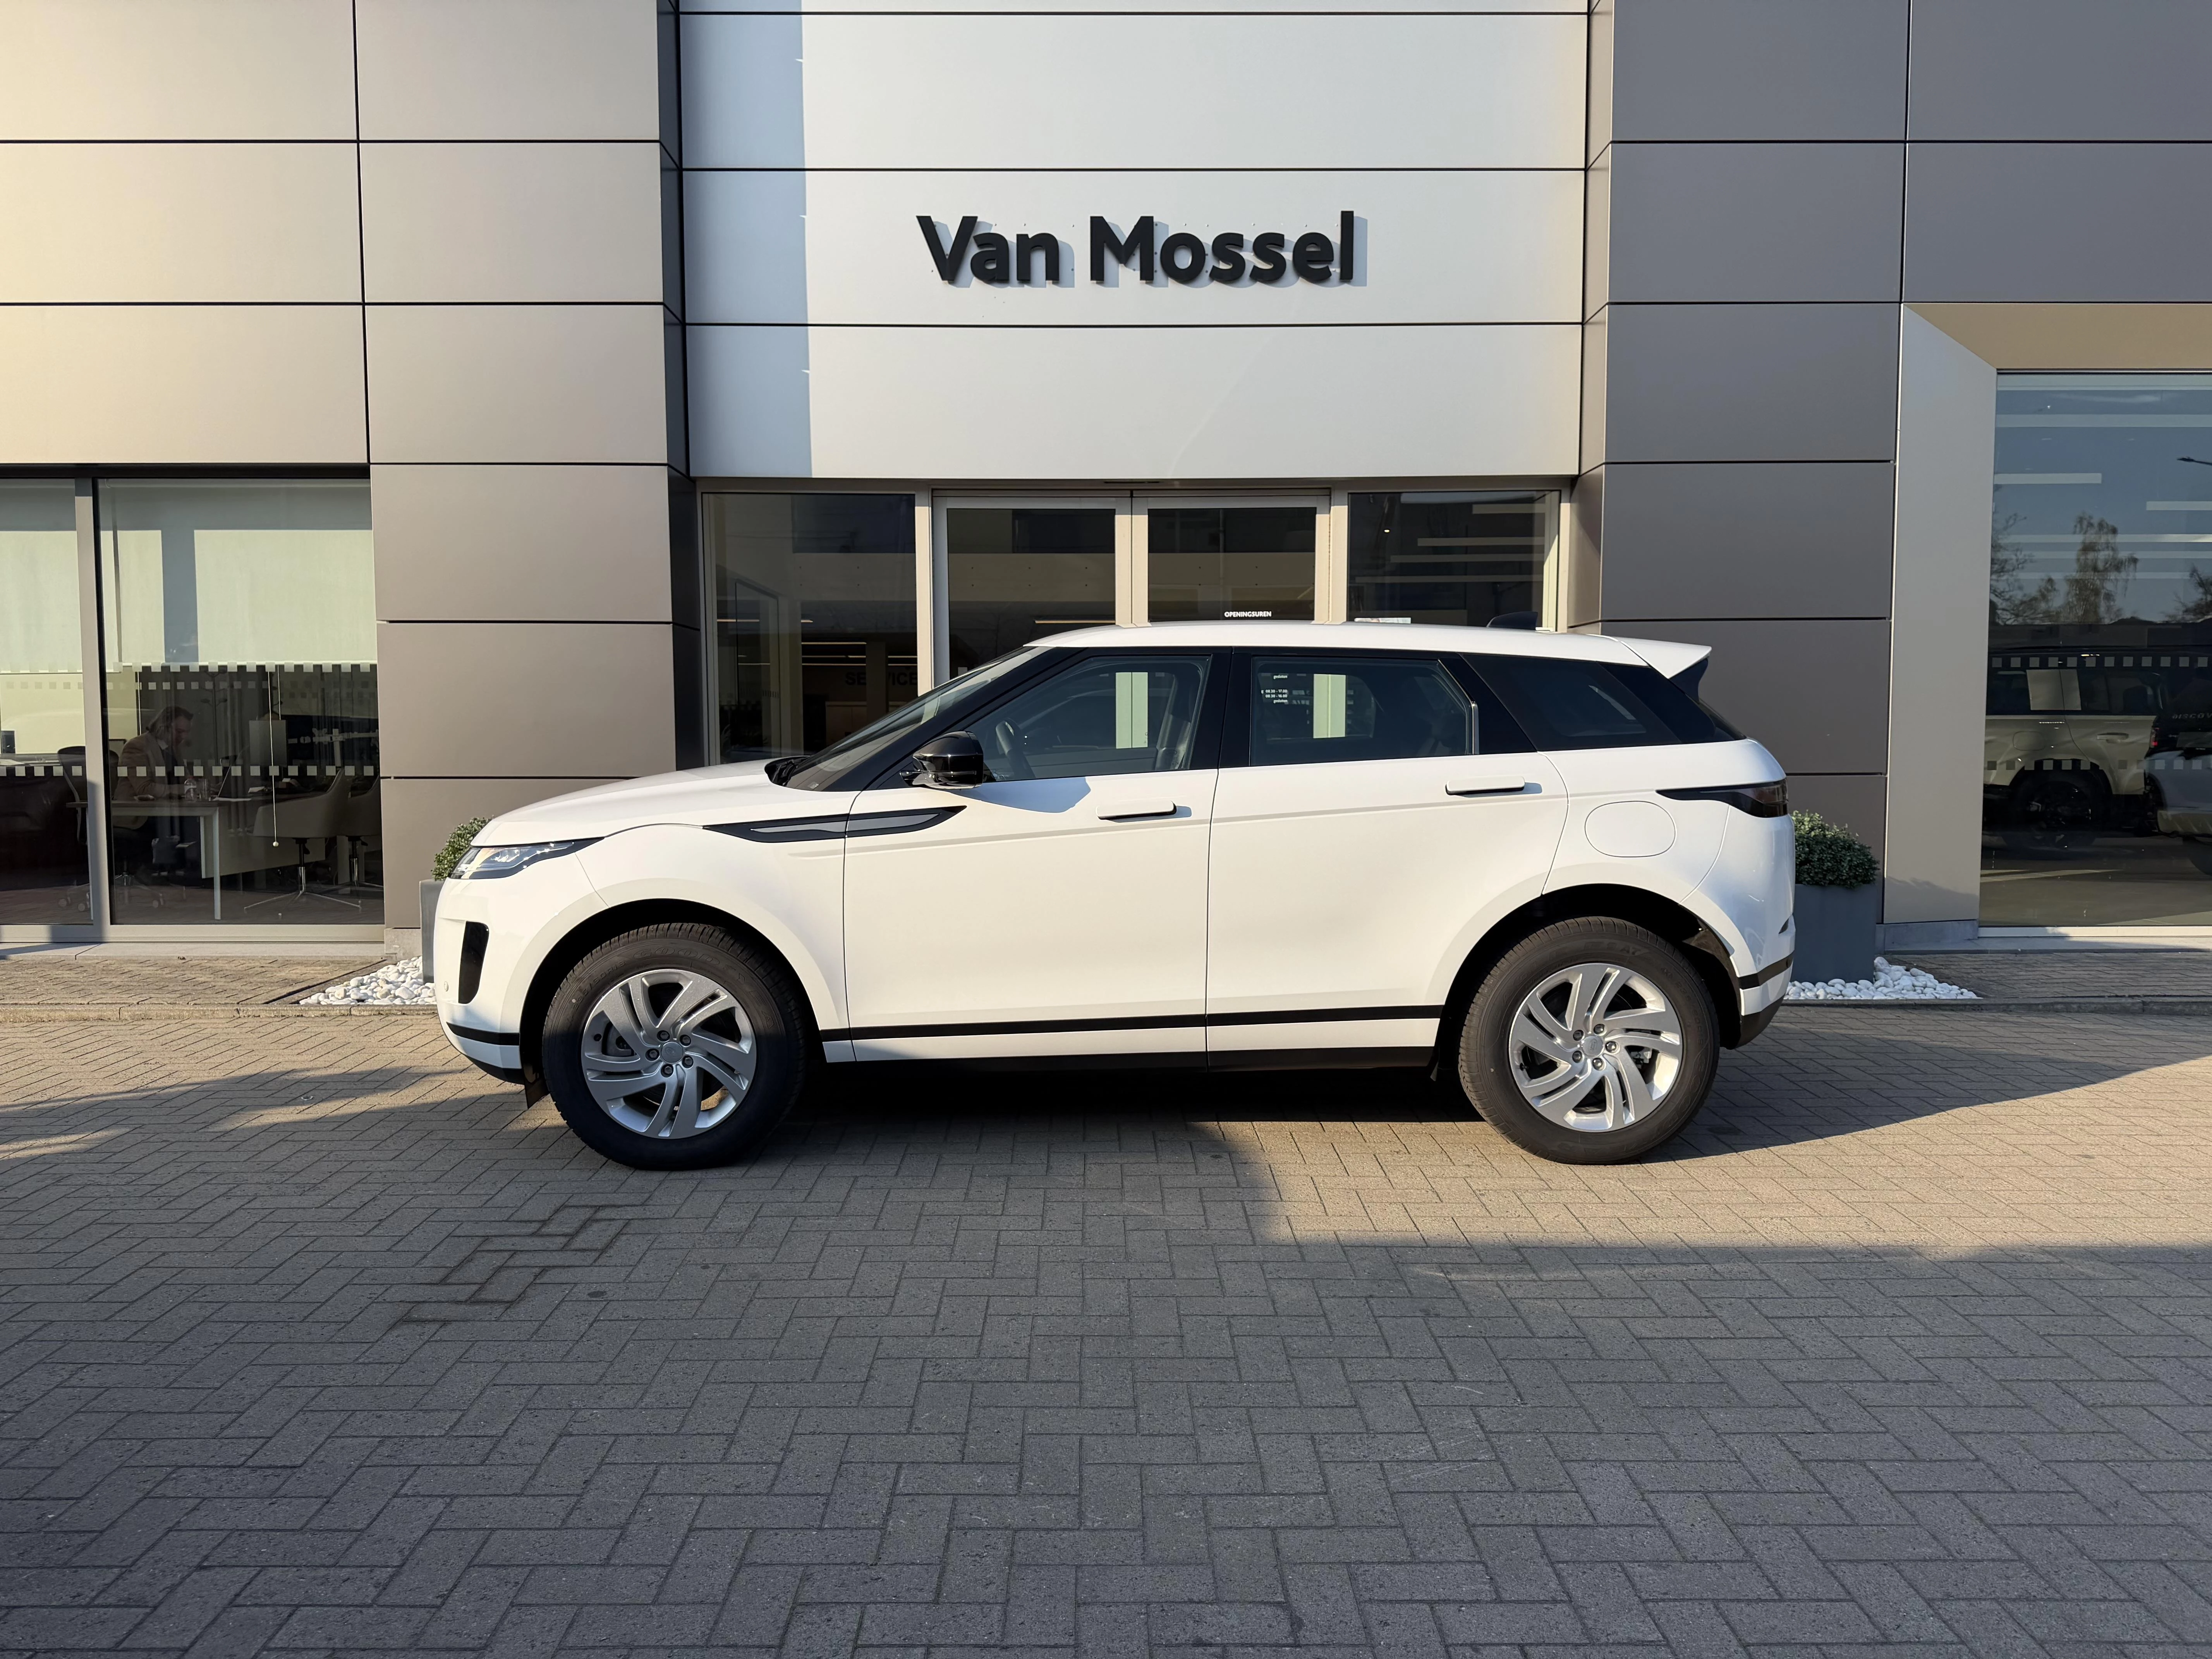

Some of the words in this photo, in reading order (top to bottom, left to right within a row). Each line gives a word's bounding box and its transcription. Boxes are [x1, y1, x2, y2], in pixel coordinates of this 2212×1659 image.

[916, 215, 1059, 282] Van
[1090, 210, 1354, 282] Mossel
[845, 672, 917, 685] SEICE
